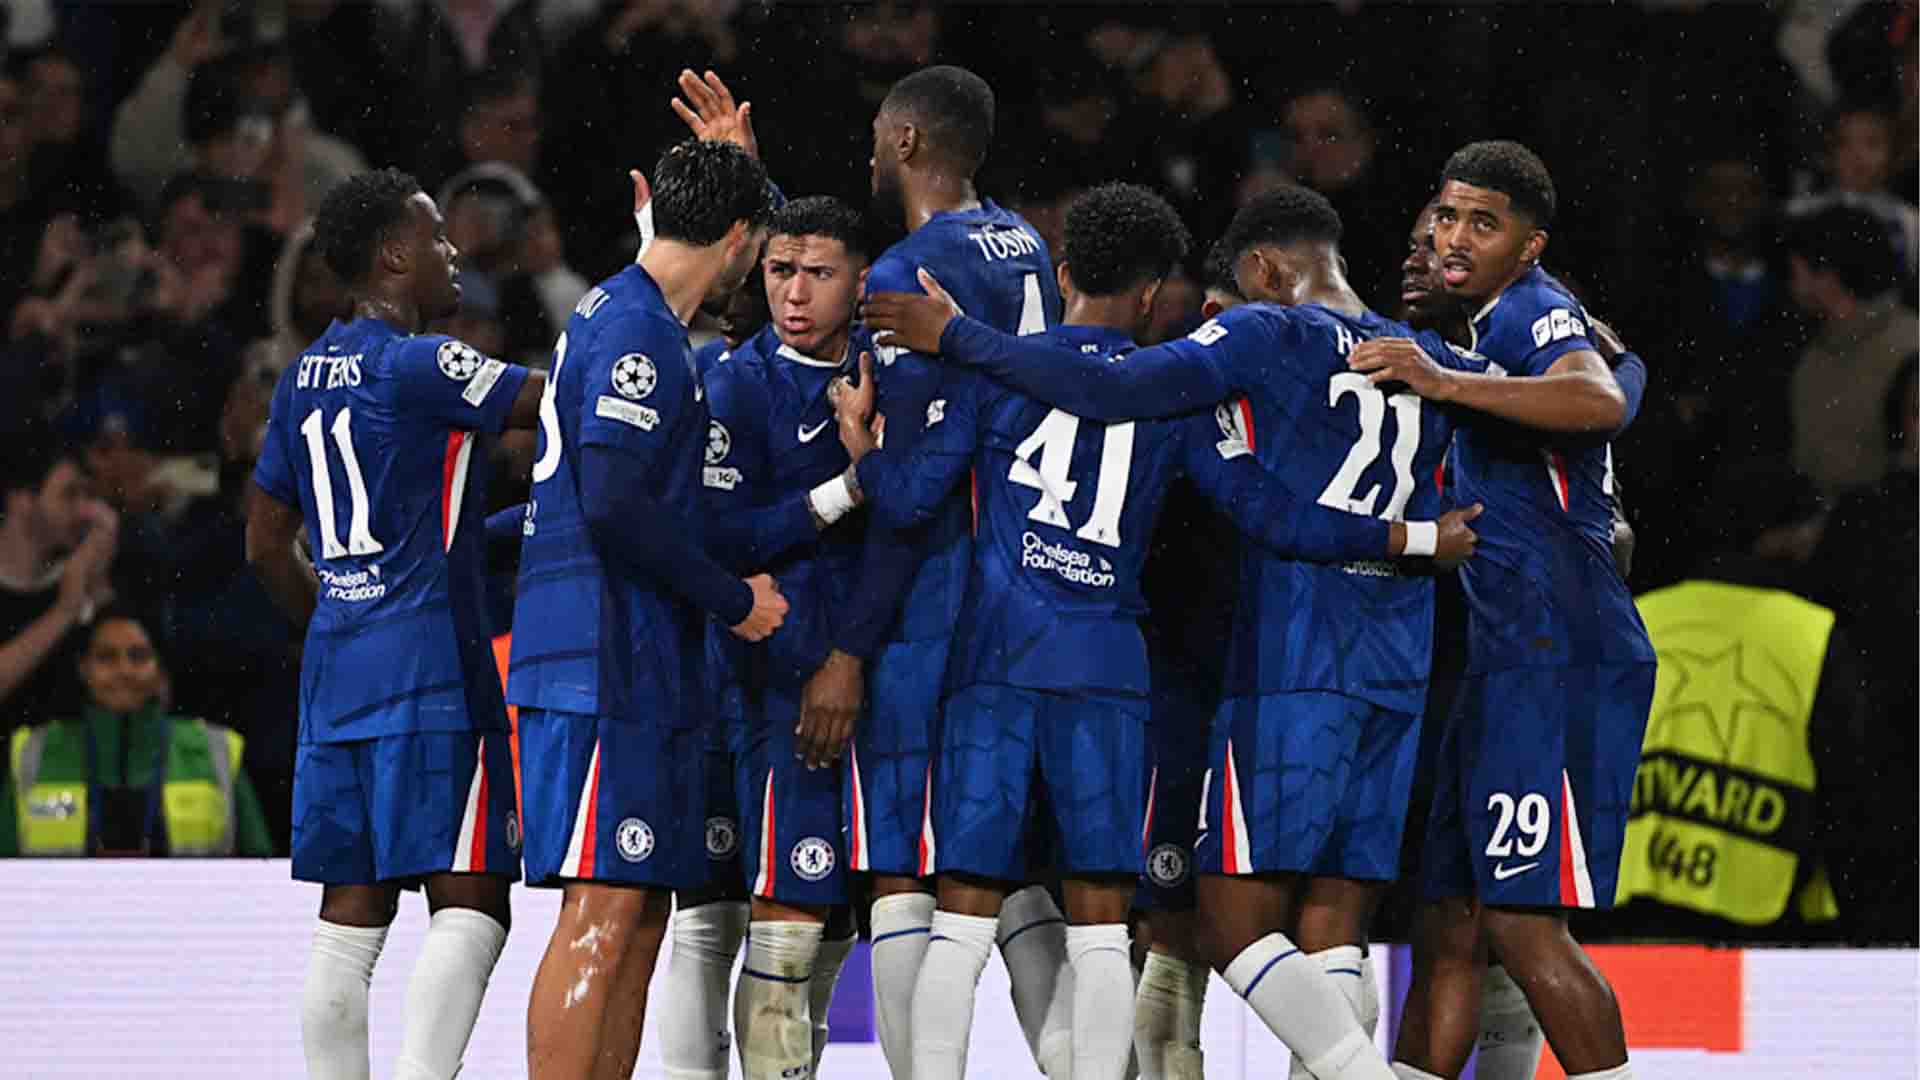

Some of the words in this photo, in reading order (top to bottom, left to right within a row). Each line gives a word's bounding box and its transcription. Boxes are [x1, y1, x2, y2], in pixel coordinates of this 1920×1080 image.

[967, 224, 1041, 261] TOSIN
[297, 353, 364, 390] GITTENS
[1007, 407, 1136, 548] 41
[1316, 371, 1421, 522] 21
[300, 406, 384, 560] 11
[1023, 531, 1091, 569] Chelsea
[1485, 792, 1550, 857] 29
